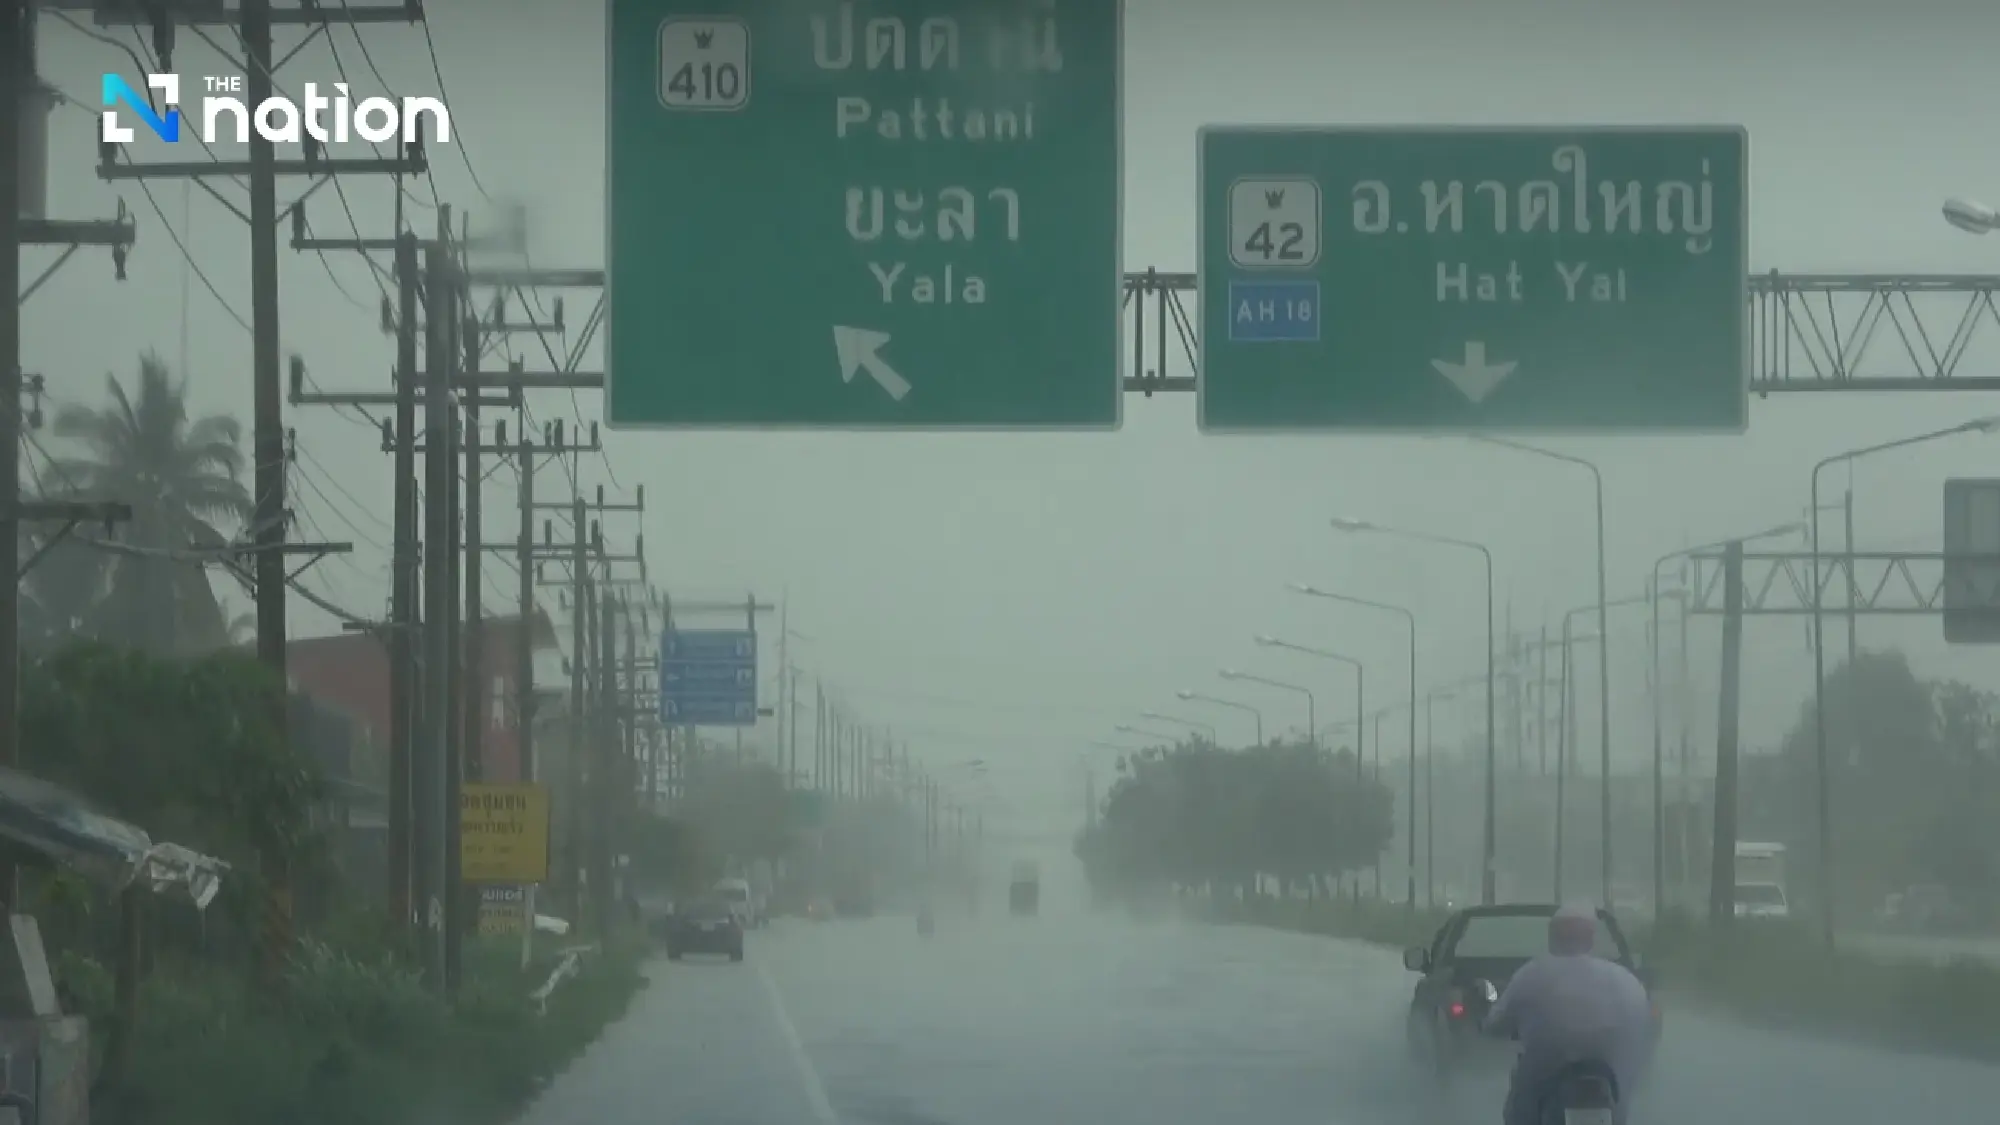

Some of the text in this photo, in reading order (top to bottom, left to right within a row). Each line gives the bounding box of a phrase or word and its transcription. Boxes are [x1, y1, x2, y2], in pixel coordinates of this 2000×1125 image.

[668, 62, 740, 100] 410
[837, 97, 1034, 139] Pattani
[845, 186, 1019, 241] ยะลา
[1351, 144, 1713, 254] อ.หาดใหญ่
[1245, 222, 1304, 260] 42
[868, 262, 986, 303] Yala
[1436, 260, 1523, 303] Hat
[1237, 298, 1275, 323] AH
